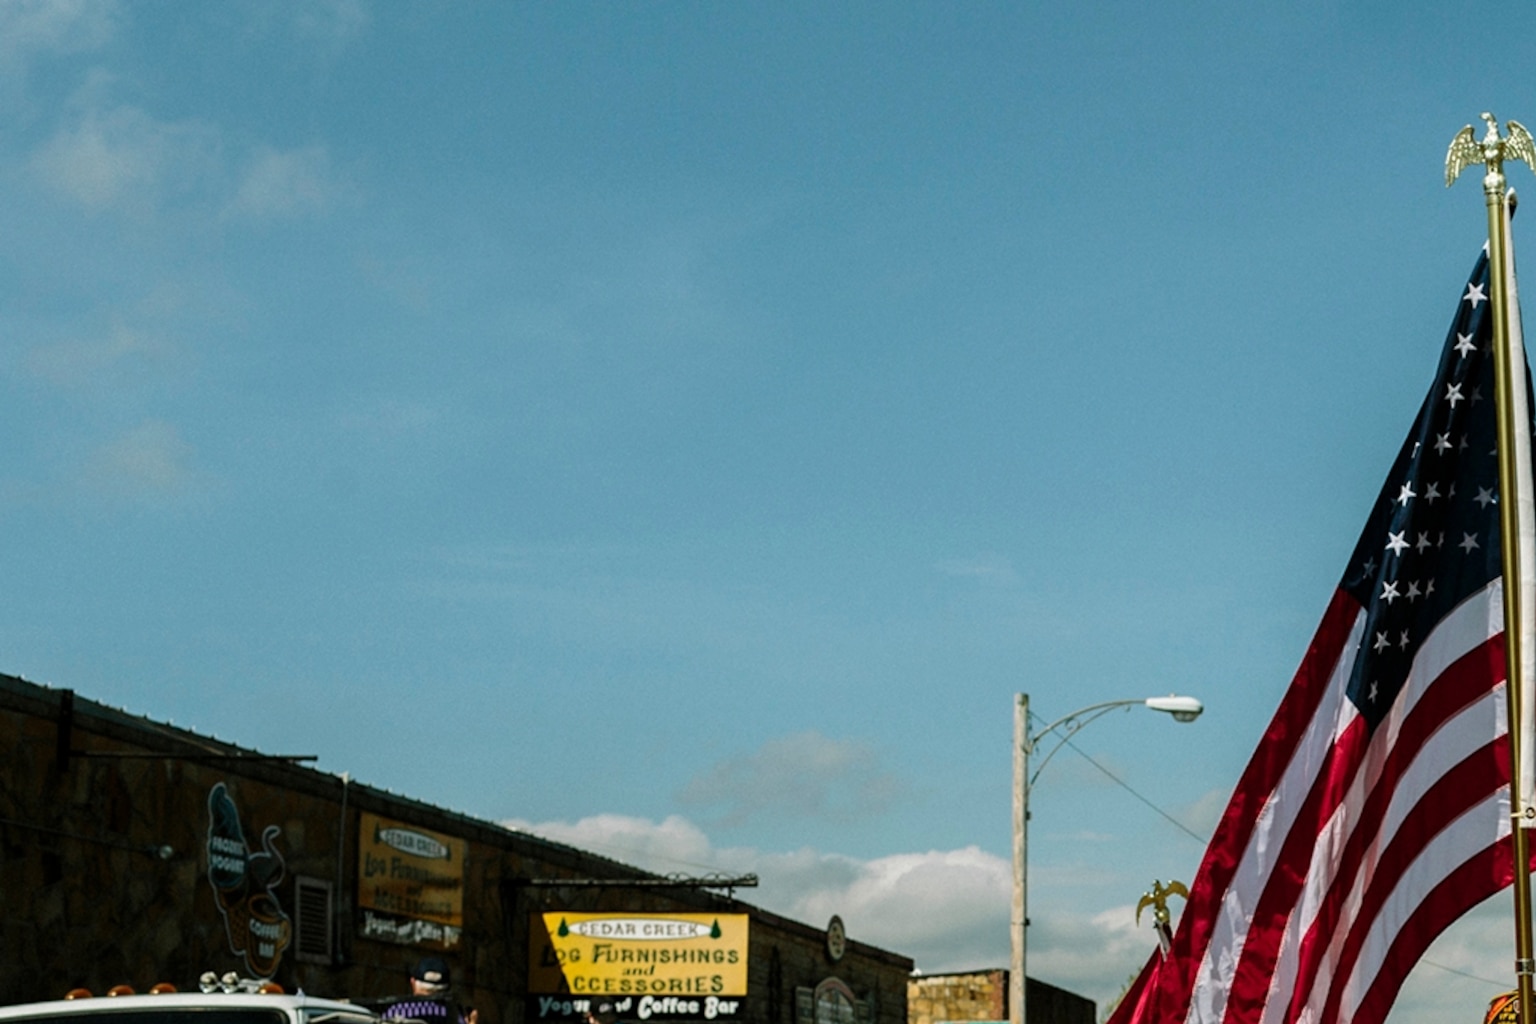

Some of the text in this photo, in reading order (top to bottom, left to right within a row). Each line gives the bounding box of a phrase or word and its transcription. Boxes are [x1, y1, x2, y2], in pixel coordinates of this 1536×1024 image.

[579, 923, 699, 936] CEDAR CREEK
[592, 944, 740, 965] FURNISHINGS
[622, 964, 656, 977] and
[559, 974, 724, 994] ACCESSORIES
[538, 995, 592, 1019] Yogur
[637, 995, 700, 1020] Coffee
[704, 996, 740, 1020] Bar
